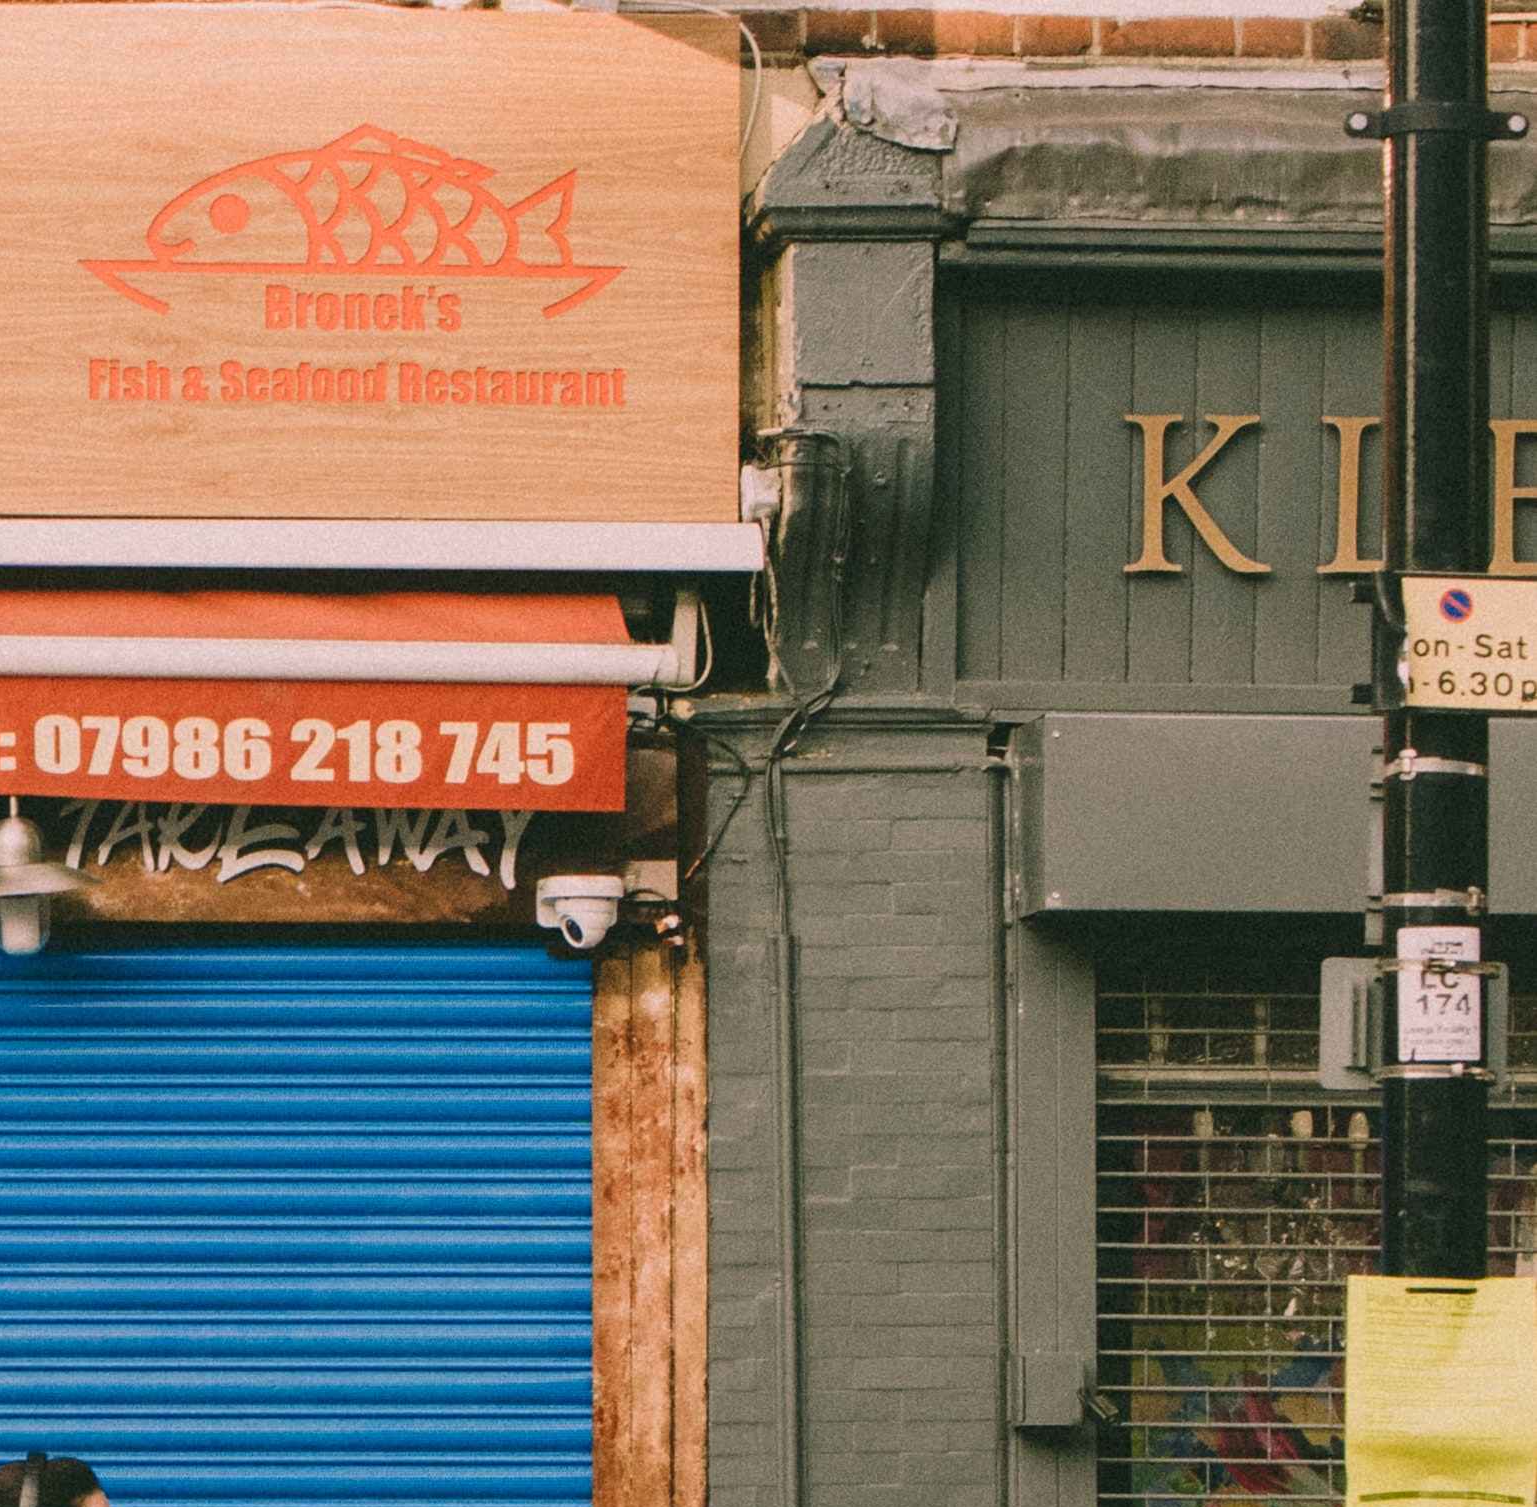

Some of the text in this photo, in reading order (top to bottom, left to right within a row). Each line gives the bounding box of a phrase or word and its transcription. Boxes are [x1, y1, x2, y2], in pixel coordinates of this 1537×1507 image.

[263, 284, 463, 333] Bronek's
[88, 359, 627, 408] Fish & Seafood Restaurant
[1413, 633, 1529, 659] on-Sat
[34, 715, 271, 781] 07986
[291, 719, 422, 784] 218
[440, 723, 574, 785] 745
[60, 801, 535, 891] TAKE AWAY
[1416, 993, 1471, 1015] 174
